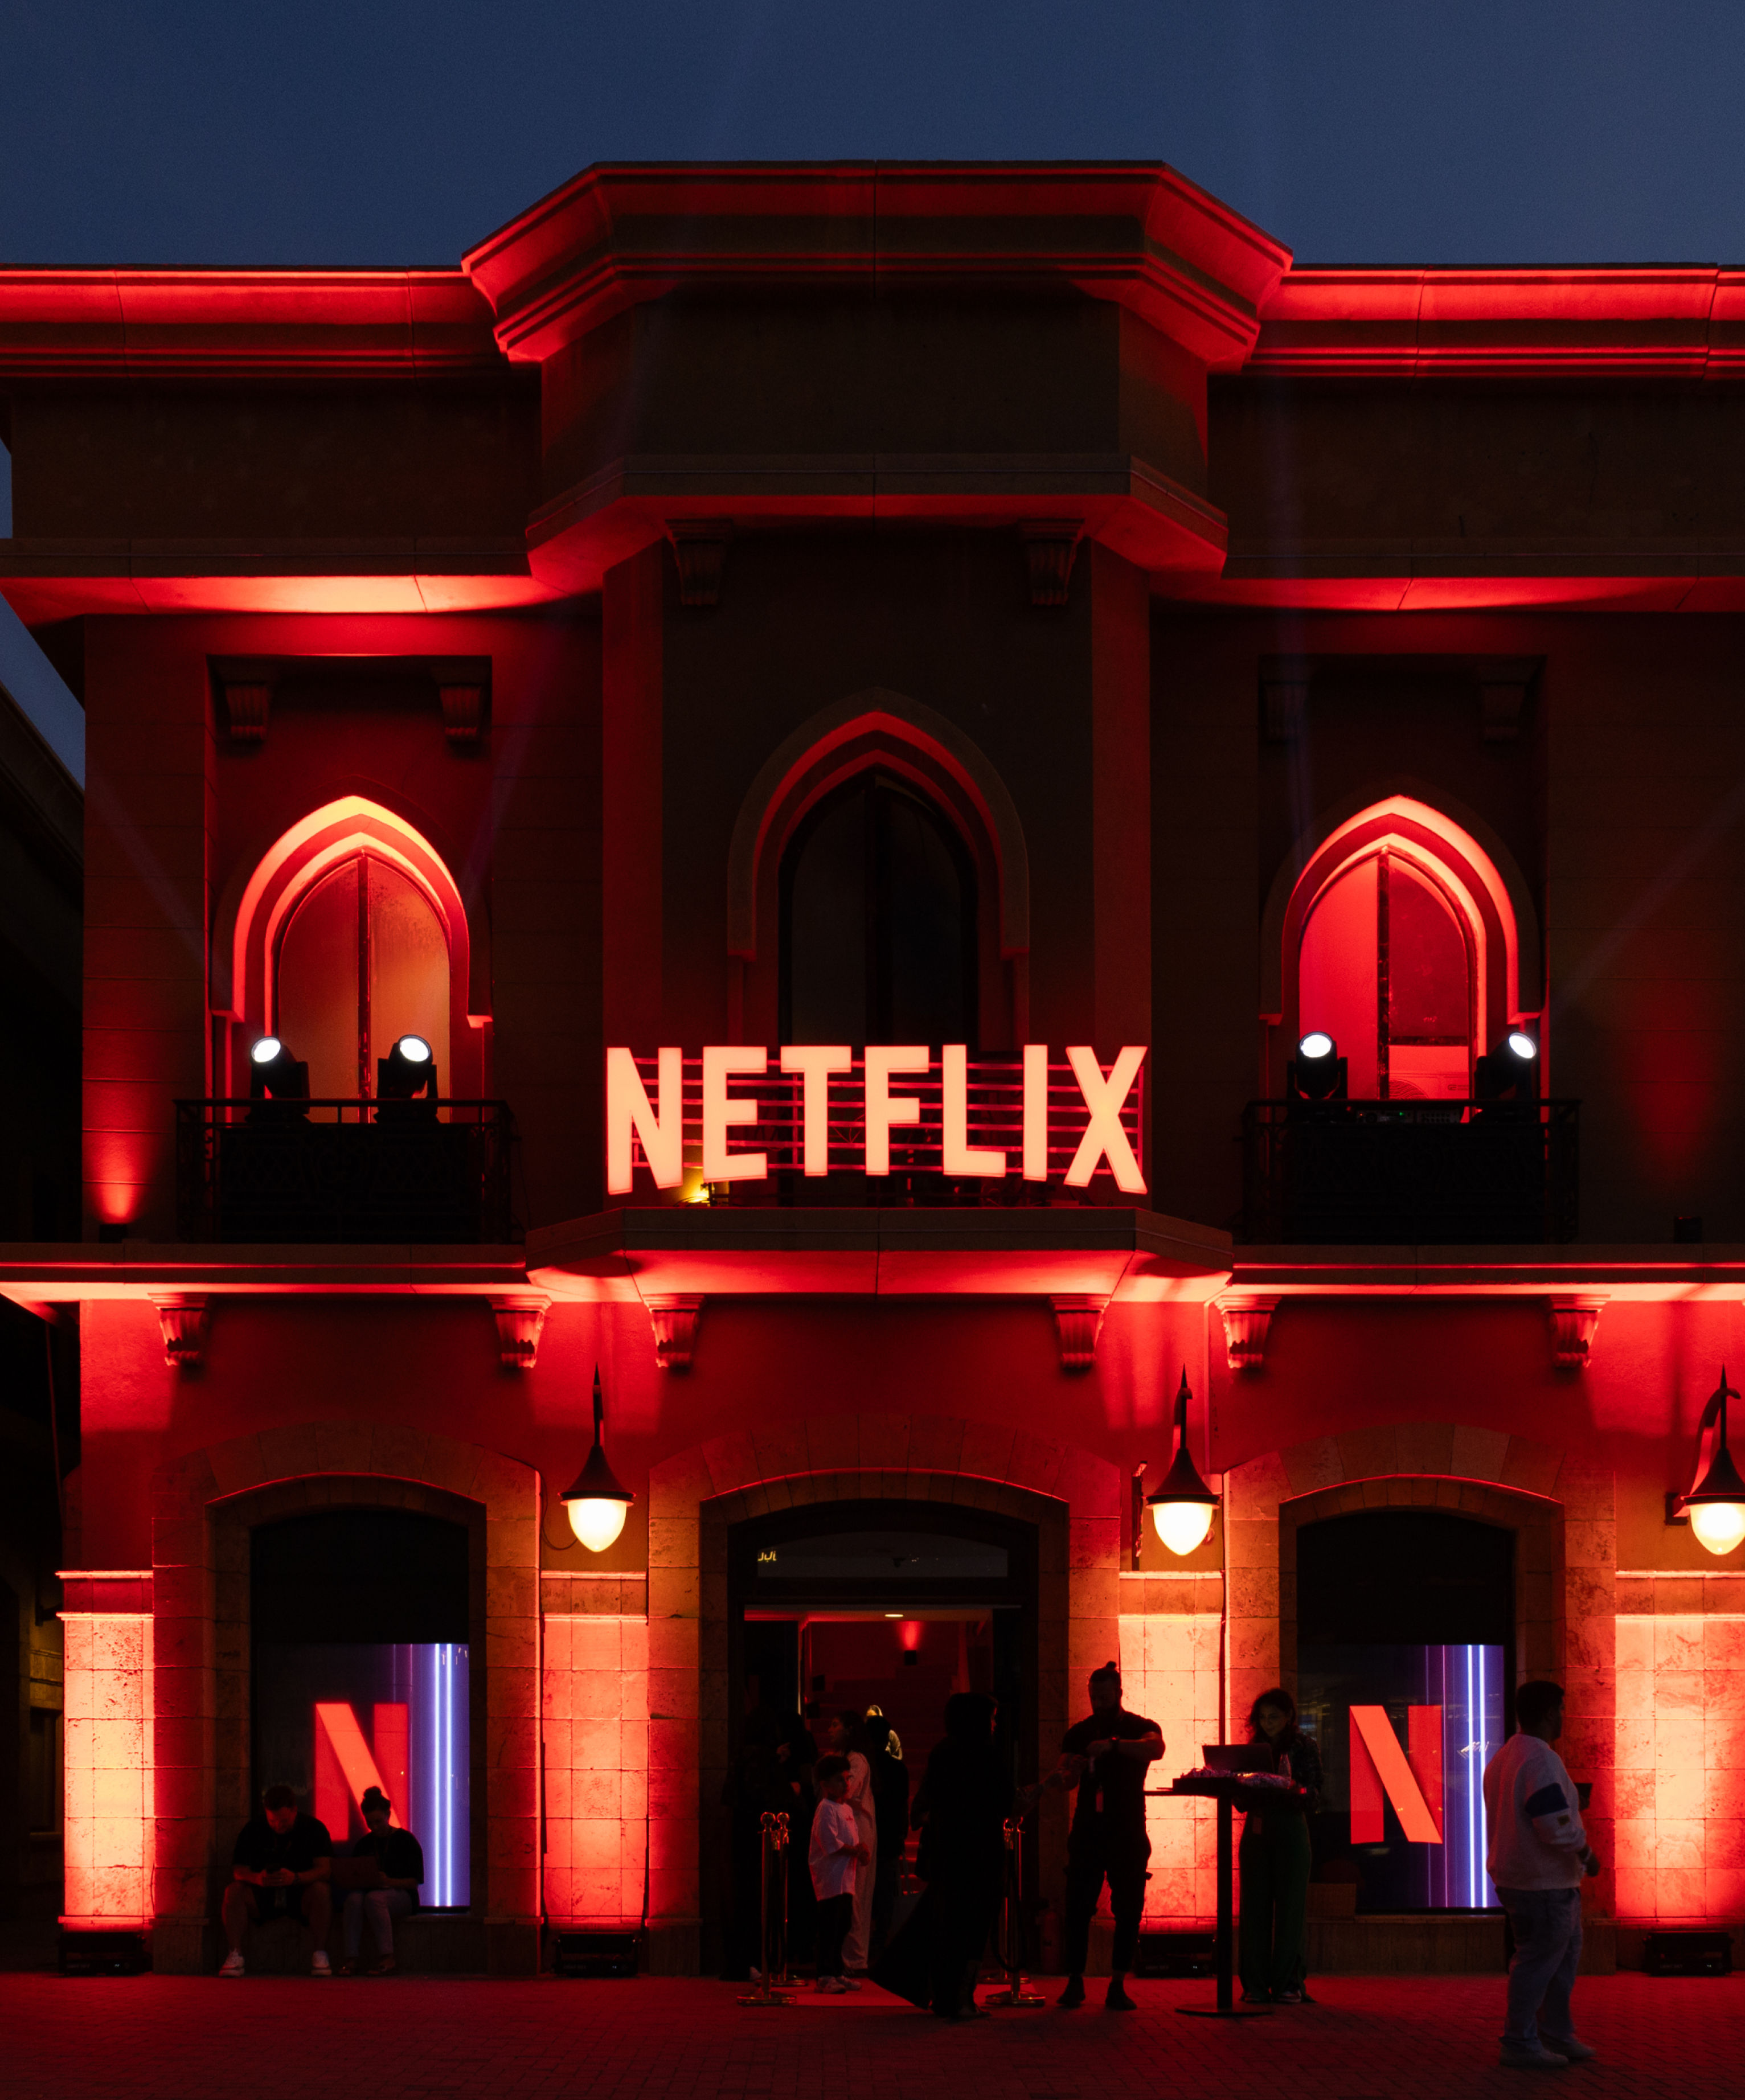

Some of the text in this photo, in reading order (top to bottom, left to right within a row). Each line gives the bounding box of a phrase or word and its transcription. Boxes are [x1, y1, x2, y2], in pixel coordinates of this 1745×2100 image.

[607, 1044, 1148, 1195] NETFLIX
[313, 1702, 408, 1843] N
[1348, 1704, 1443, 1844] N
